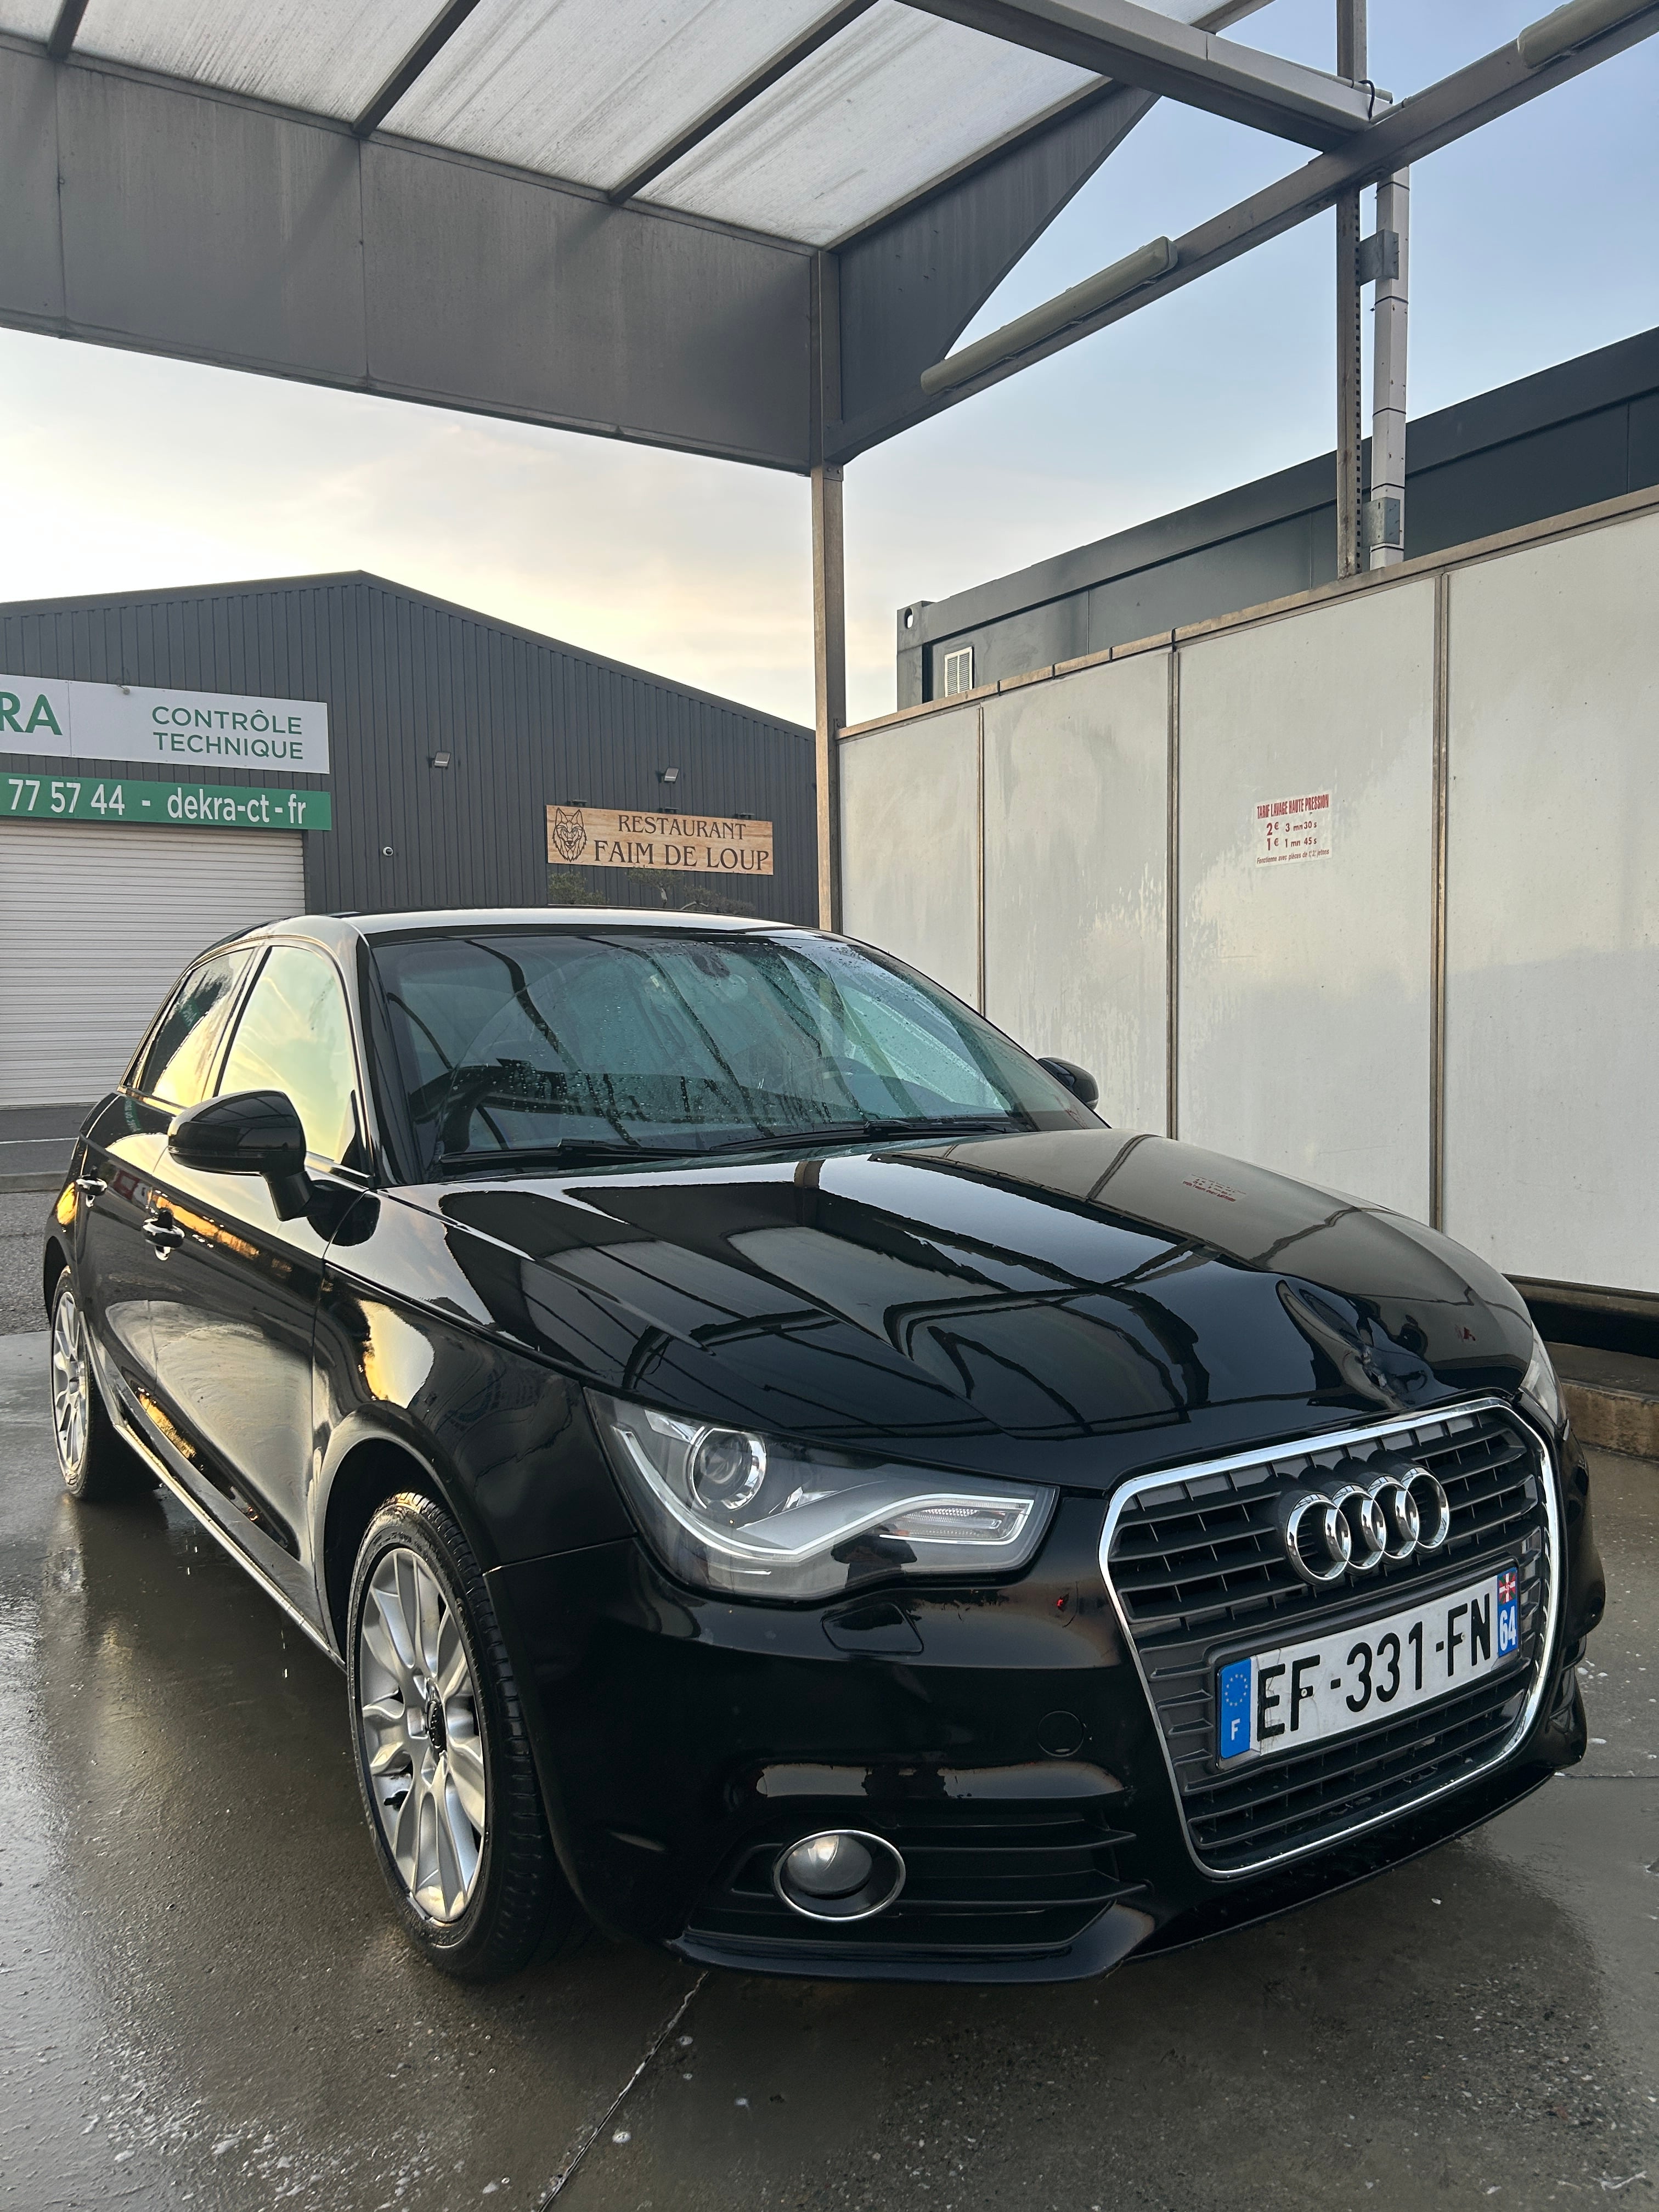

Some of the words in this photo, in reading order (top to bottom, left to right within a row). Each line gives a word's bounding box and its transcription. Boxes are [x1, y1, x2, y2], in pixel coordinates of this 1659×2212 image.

[152, 706, 302, 735] CONTRÔLE
[153, 732, 303, 759] TECHNIQUE
[9, 778, 40, 811] 77
[51, 781, 81, 813] 57
[91, 784, 125, 815] 44
[1257, 804, 1270, 819] TARIF
[1271, 801, 1288, 817] LAVAGE
[1289, 798, 1304, 814] HAUTE
[1305, 794, 1329, 811] PRESSION
[618, 815, 747, 840] RESTAURANT
[1285, 822, 1290, 832] 3
[1304, 821, 1312, 829] 30
[594, 840, 654, 864] FAIM
[664, 844, 698, 867] DE
[706, 847, 769, 871] LOUP
[1285, 838, 1288, 848] 1
[1304, 837, 1312, 845] 45
[1498, 1605, 1517, 1651] 64
[1256, 1593, 1491, 1742] EF-331-FN
[1231, 1718, 1240, 1741] F
